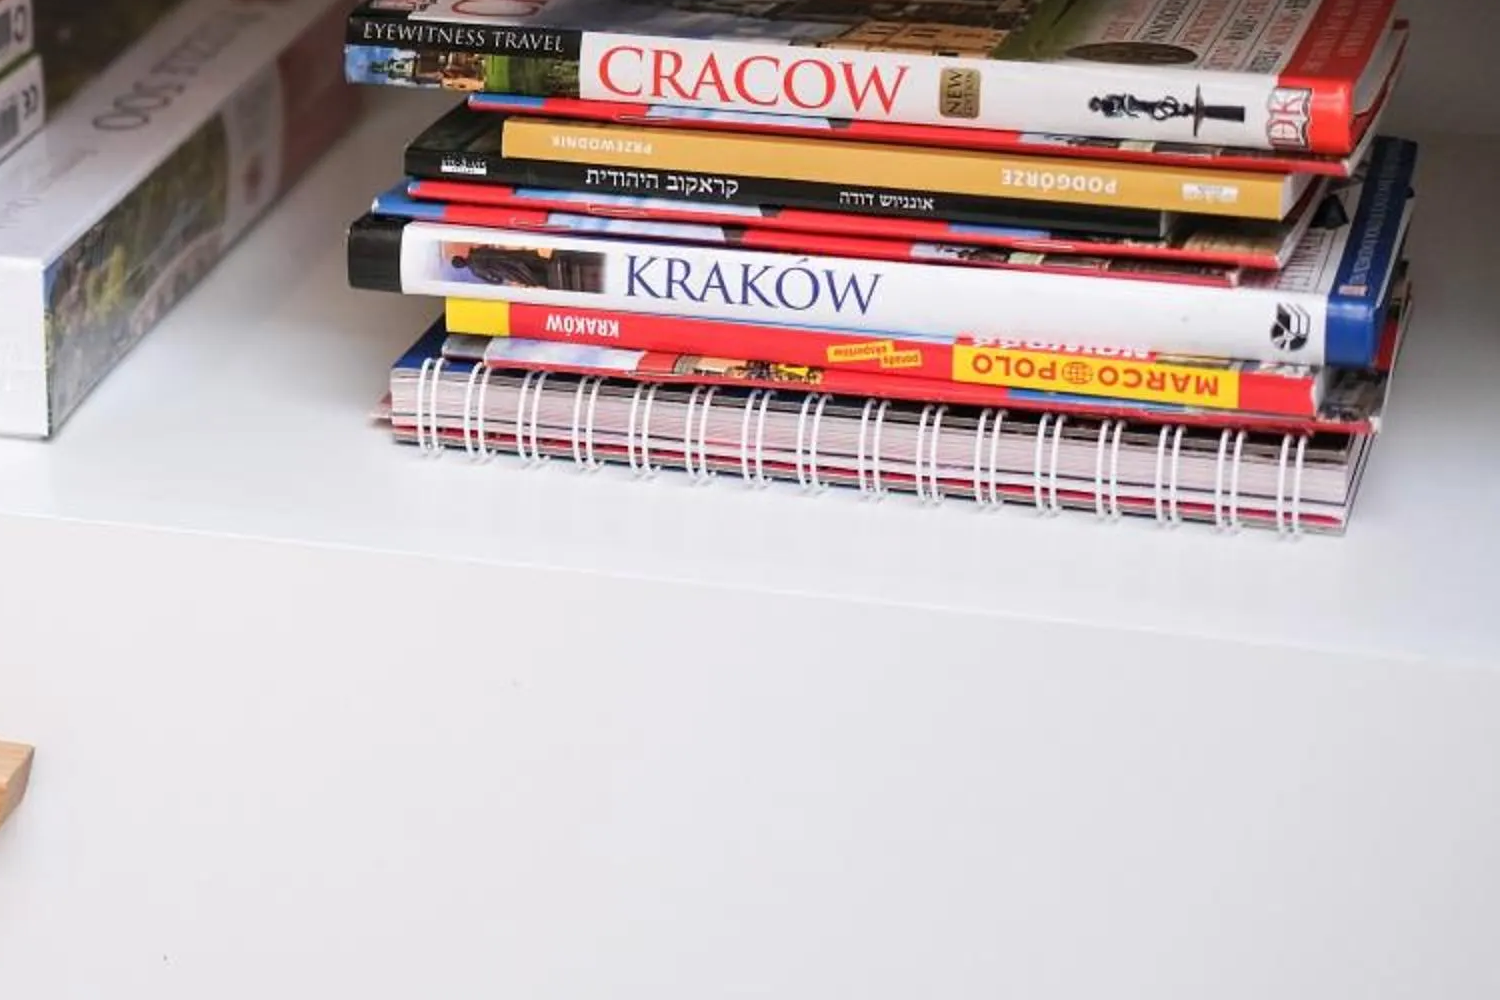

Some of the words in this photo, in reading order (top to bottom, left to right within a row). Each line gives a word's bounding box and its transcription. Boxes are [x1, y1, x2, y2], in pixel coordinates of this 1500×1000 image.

[363, 22, 485, 47] EYEWITNESS
[491, 30, 564, 53] TRAVEL
[599, 45, 911, 115] CRACOW
[946, 68, 963, 115] NEW
[552, 134, 652, 156] PRZEWODNIK
[585, 168, 659, 188] היהודית
[666, 174, 739, 198] קראקוב
[1000, 167, 1118, 195] PODGÓRZE
[626, 257, 884, 315] KRAKÓW
[546, 313, 620, 339] KRAKÓW
[972, 353, 1057, 385] POLO
[1099, 366, 1219, 399] MARCO
